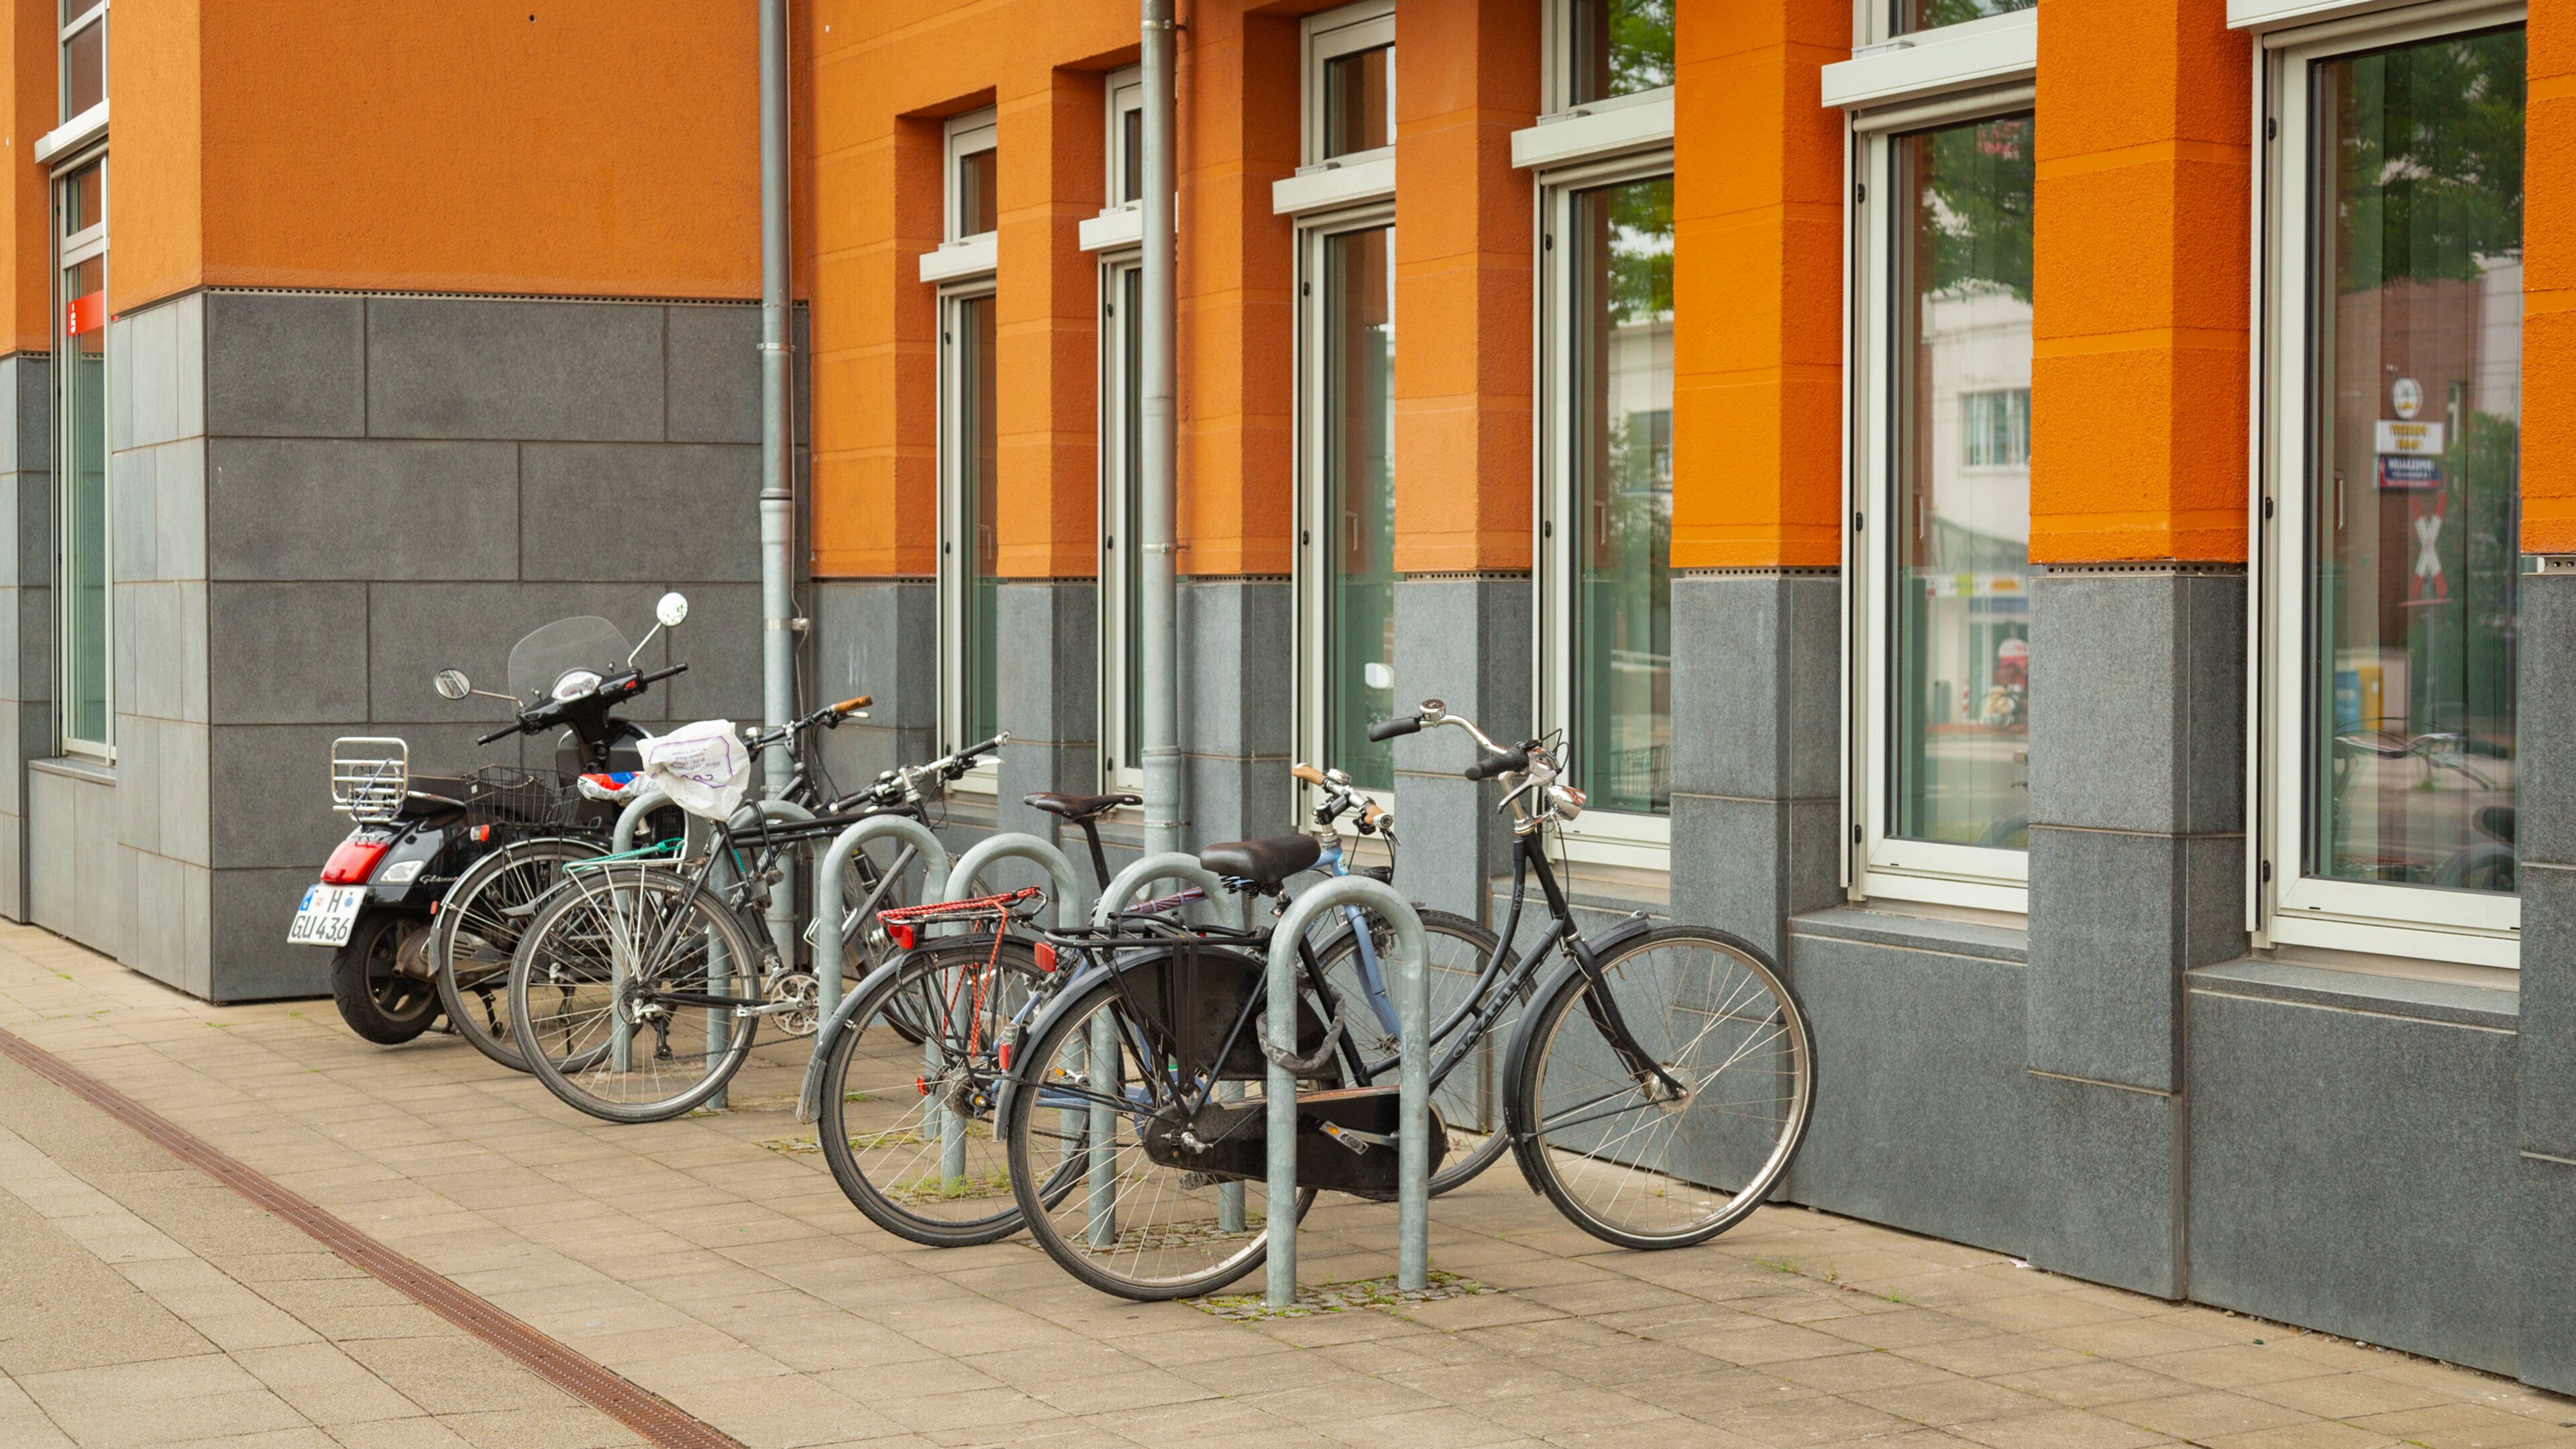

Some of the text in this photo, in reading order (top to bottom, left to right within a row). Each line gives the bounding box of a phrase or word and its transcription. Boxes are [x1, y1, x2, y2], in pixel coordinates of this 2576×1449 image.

[303, 901, 309, 909] D
[327, 890, 343, 912] H
[1453, 971, 1525, 1058] GAZELLE
